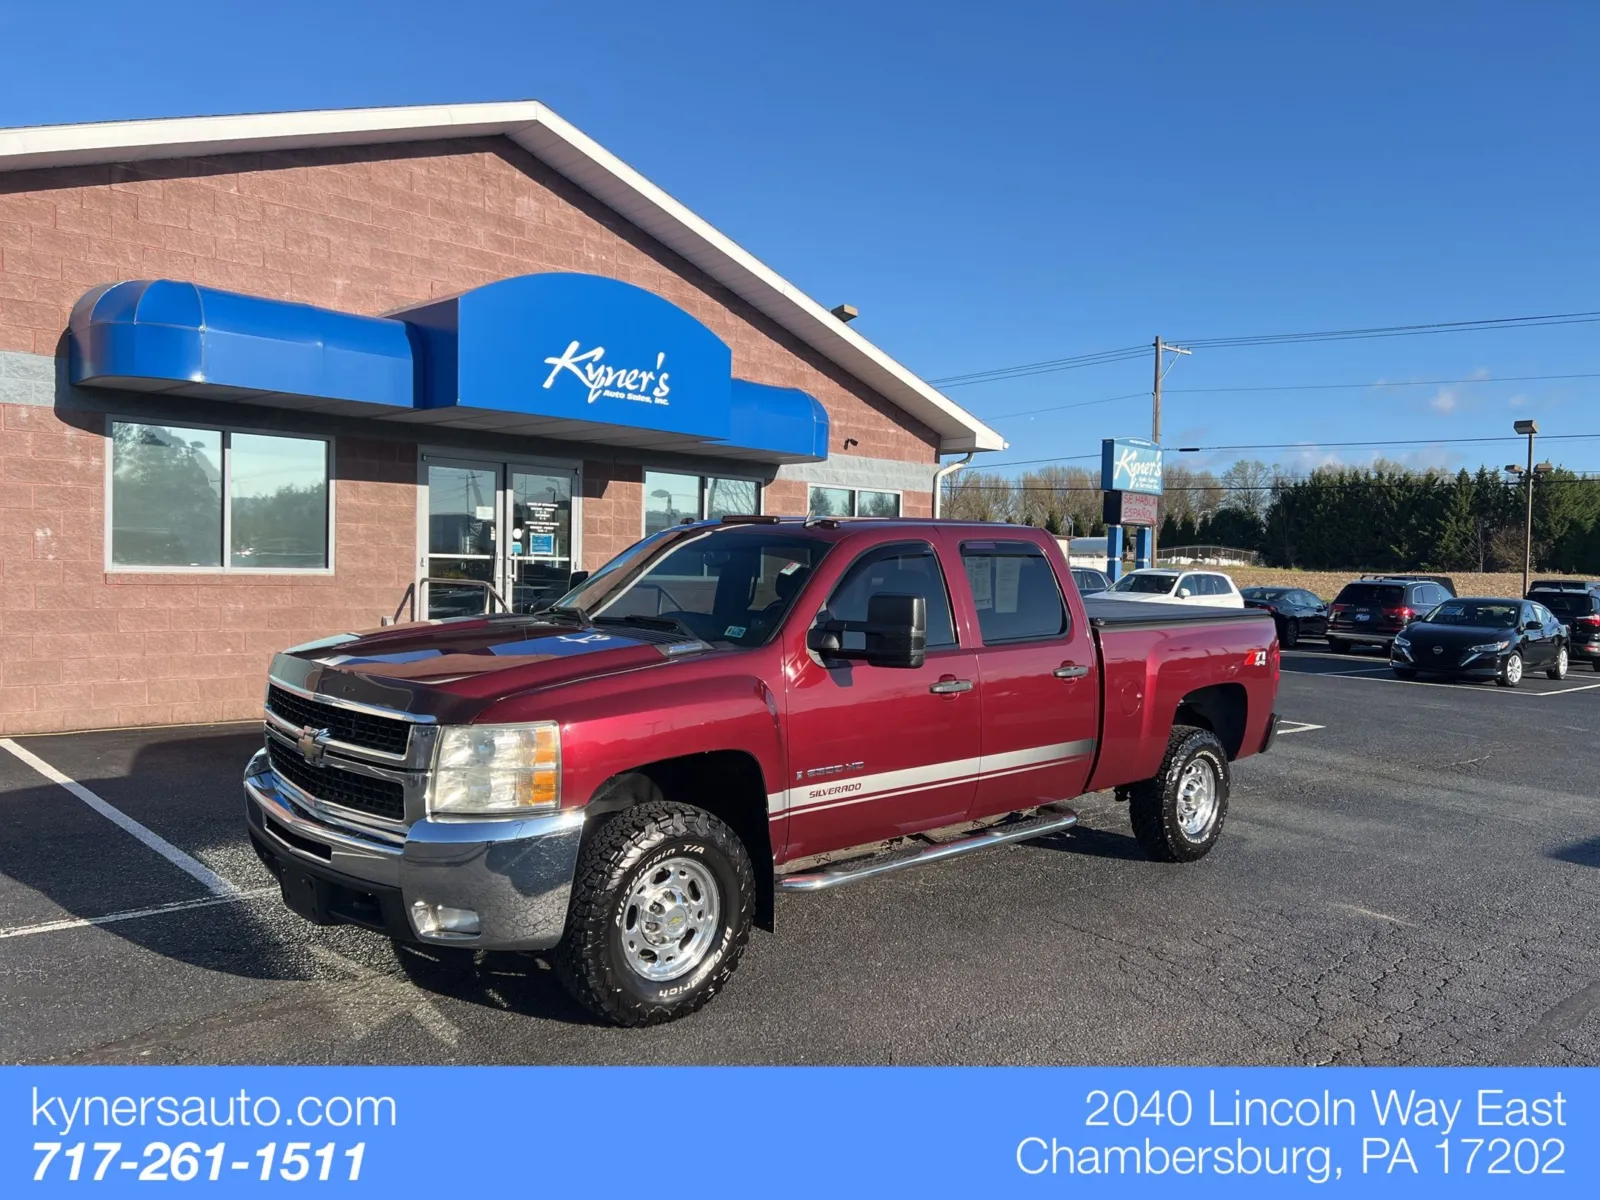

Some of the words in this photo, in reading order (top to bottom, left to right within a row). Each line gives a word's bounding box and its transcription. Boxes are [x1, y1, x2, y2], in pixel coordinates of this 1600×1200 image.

[542, 340, 670, 404] Kyner's
[603, 389, 625, 400] Auto
[626, 393, 652, 404] Sales,
[654, 397, 670, 406] Inc.
[1114, 448, 1162, 490] Kyner's
[1123, 494, 1133, 504] SE
[1135, 495, 1157, 507] HABLA
[1123, 507, 1152, 519] ESPAÑOL
[809, 782, 862, 799] SILVERADO
[683, 844, 705, 855] T/A
[658, 926, 733, 998] BFGoodrich
